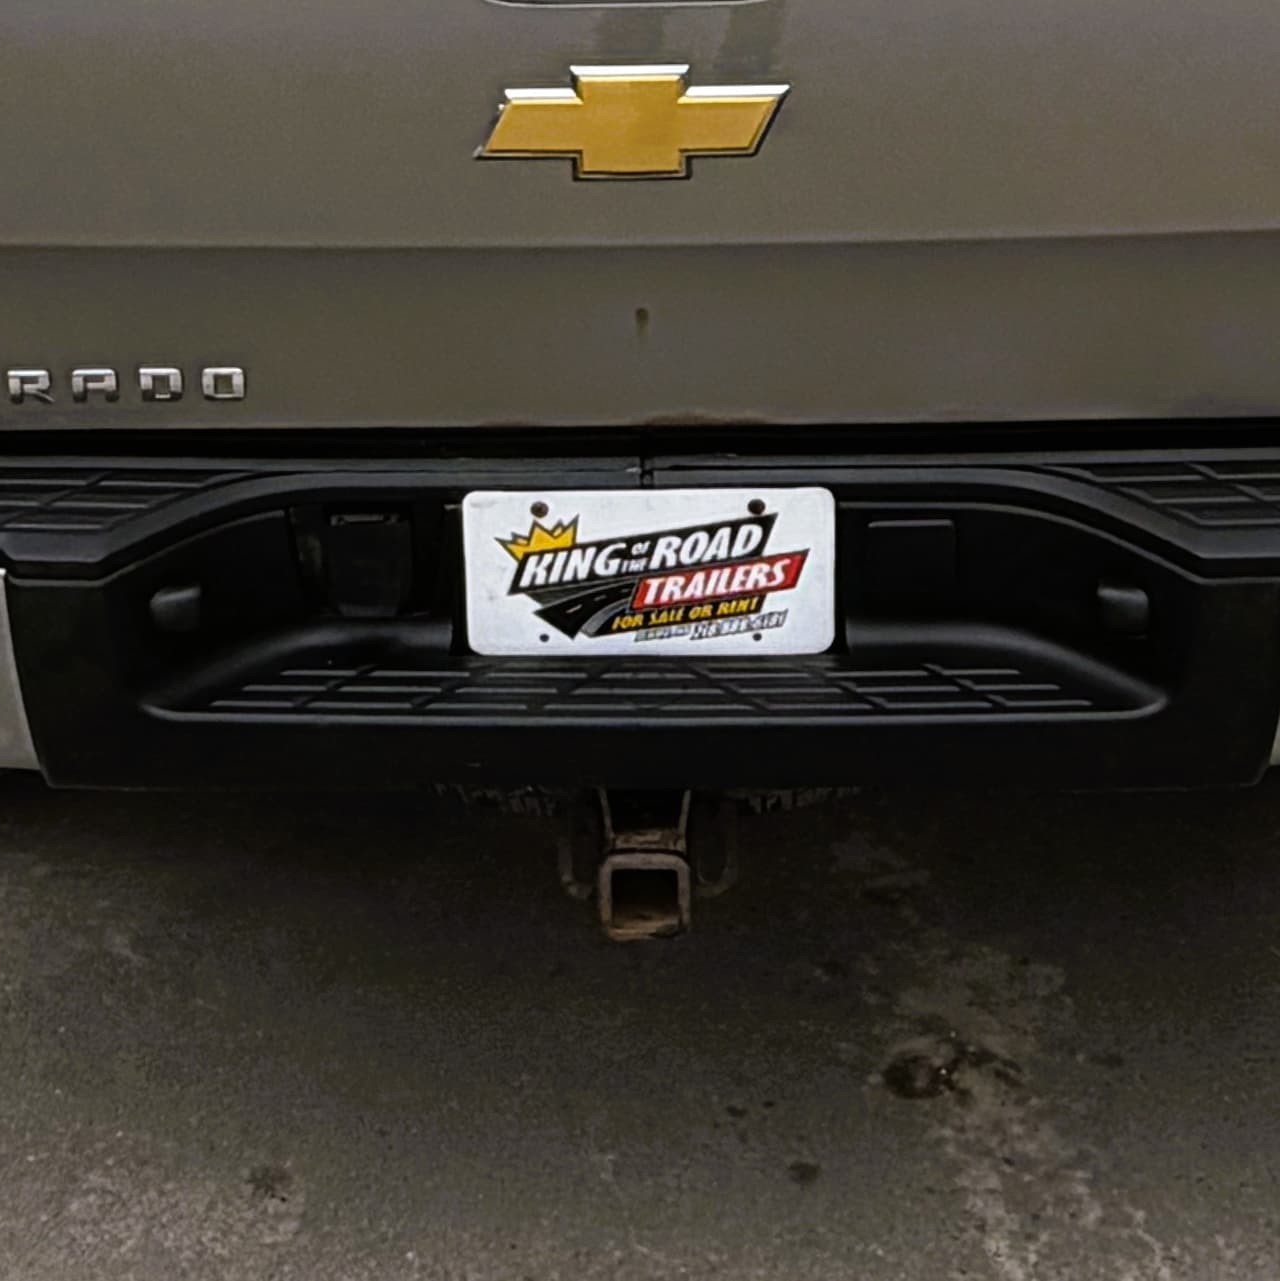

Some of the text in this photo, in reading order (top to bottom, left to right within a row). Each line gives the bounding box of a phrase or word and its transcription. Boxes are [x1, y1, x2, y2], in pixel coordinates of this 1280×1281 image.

[519, 542, 627, 588] KING
[648, 523, 764, 570] ROAD
[643, 558, 791, 605] TRAILERS
[611, 613, 643, 631] FOR
[649, 606, 684, 626] SALE
[688, 604, 714, 619] OR
[716, 596, 760, 616] RENT
